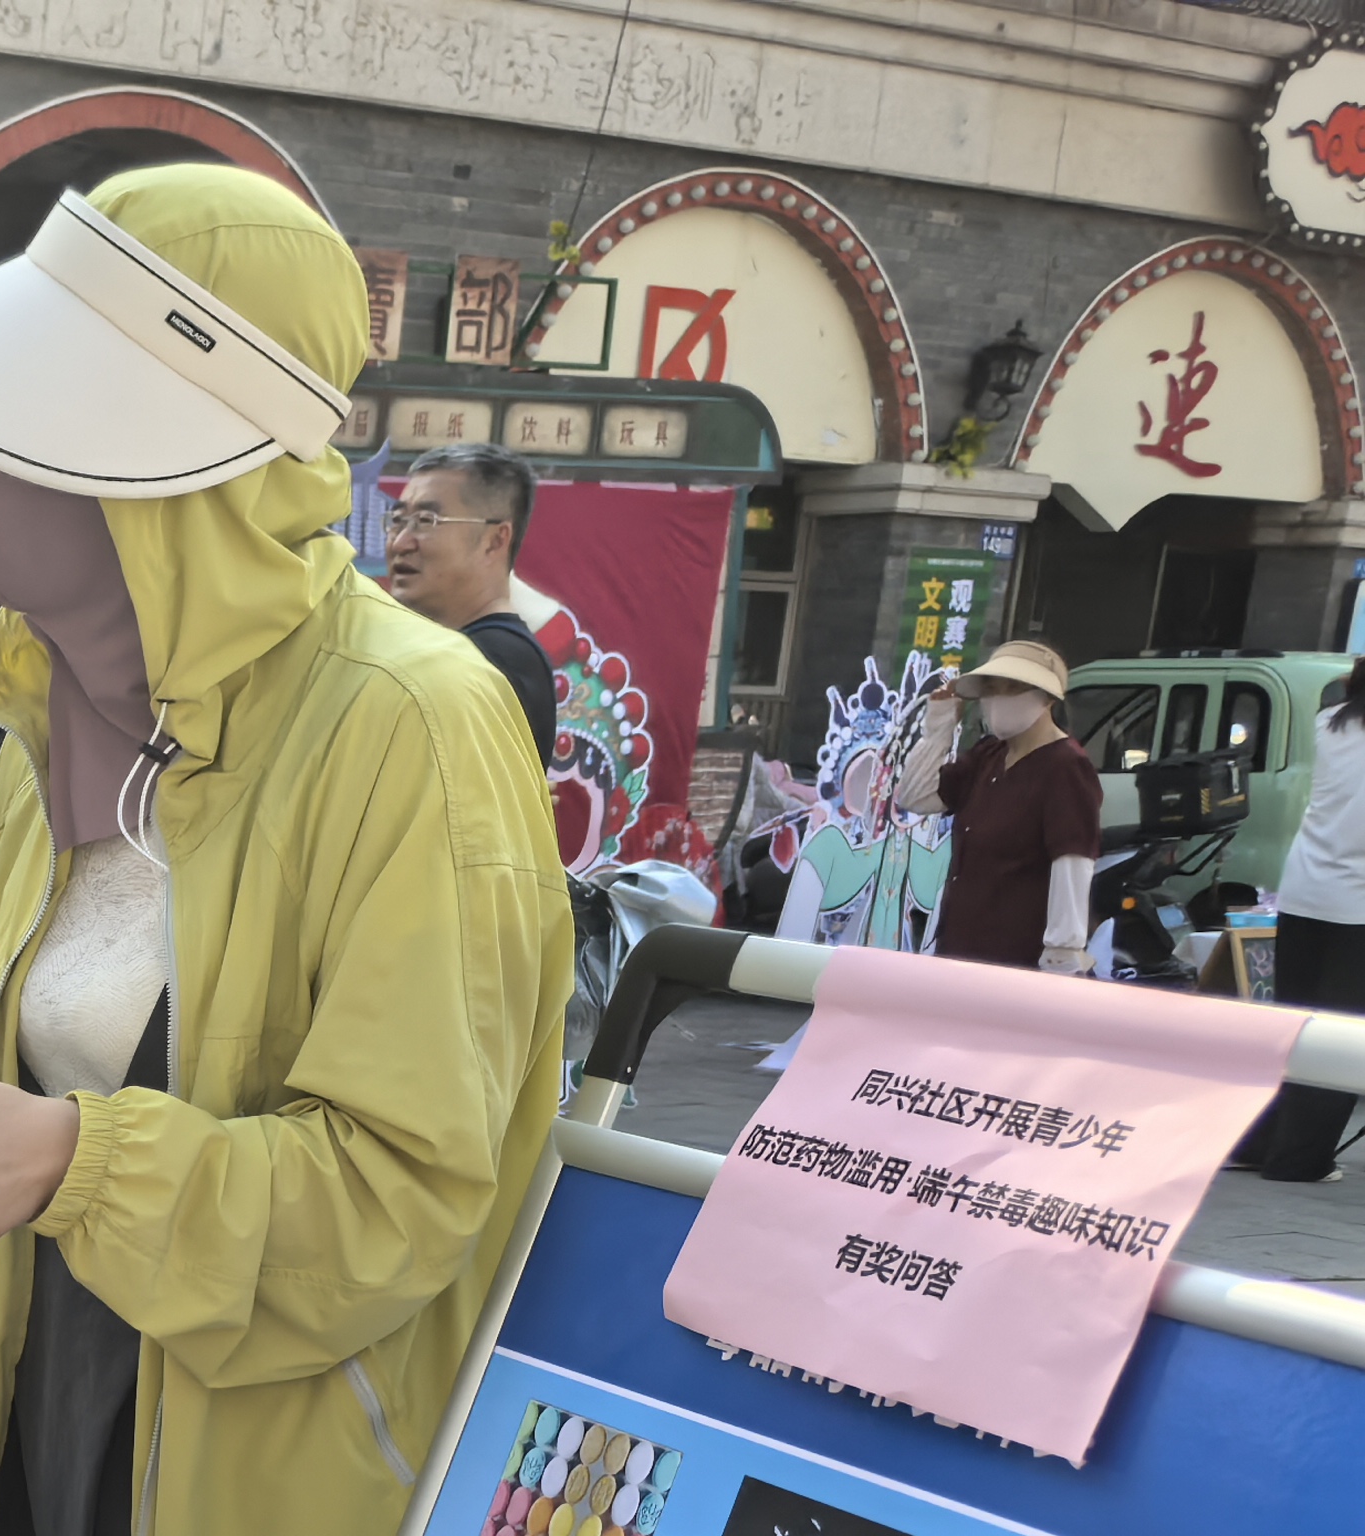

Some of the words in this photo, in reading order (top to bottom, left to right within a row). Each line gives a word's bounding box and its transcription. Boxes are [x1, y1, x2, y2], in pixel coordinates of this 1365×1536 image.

[412, 411, 464, 438] 报纸
[520, 416, 573, 446] 饮料
[620, 420, 669, 447] 玩具
[851, 1068, 1136, 1159] 同兴社区开展青少年
[835, 1234, 963, 1301] 有奖问答
